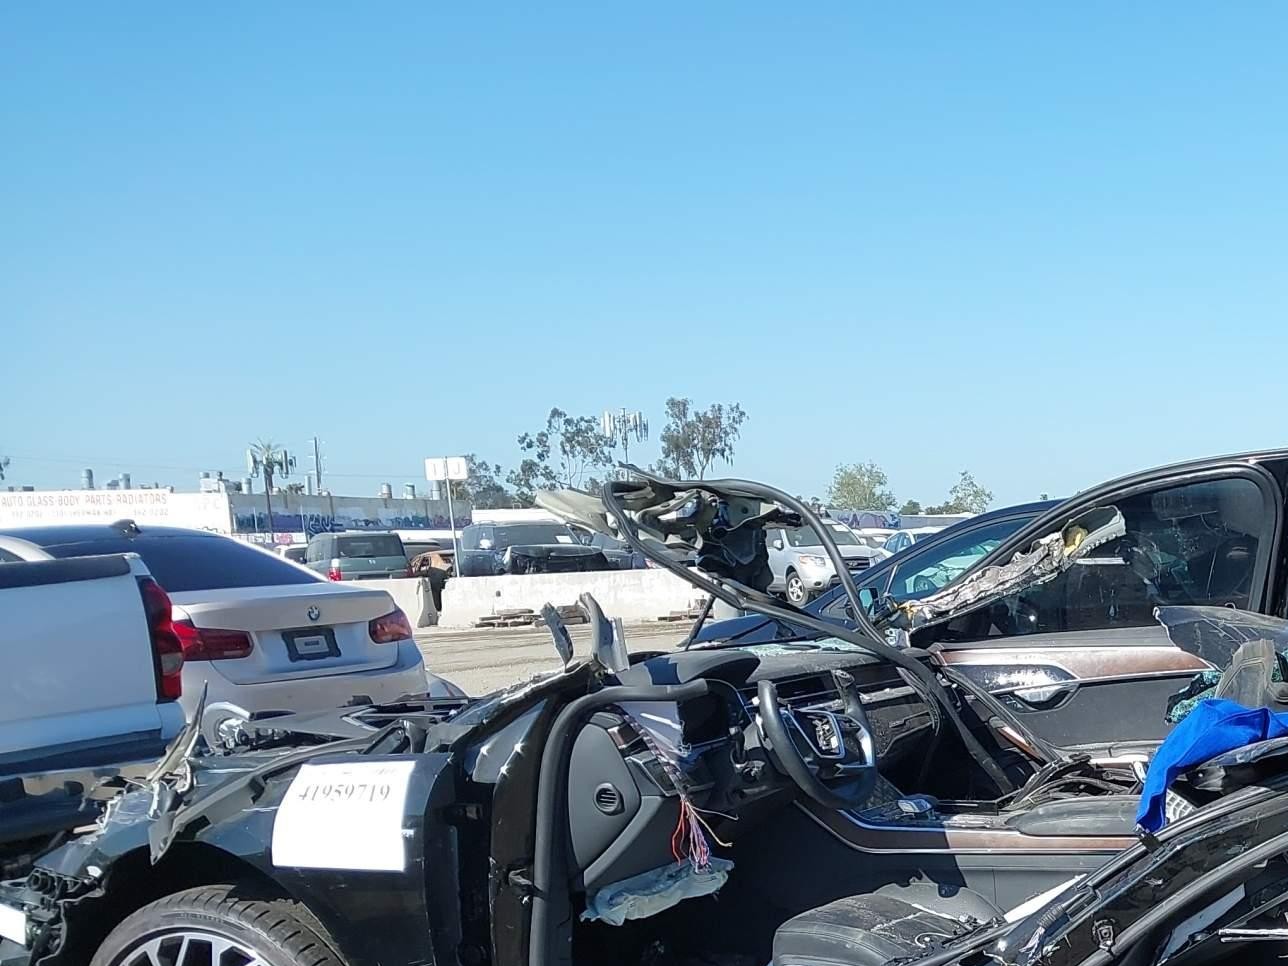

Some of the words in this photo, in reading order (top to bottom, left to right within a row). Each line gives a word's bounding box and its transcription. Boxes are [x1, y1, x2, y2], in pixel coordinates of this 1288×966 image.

[1, 495, 24, 507] AUTO
[27, 495, 55, 507] GLASS
[58, 495, 80, 506] BODY
[85, 494, 112, 506] PARTS
[116, 493, 167, 505] RADIATORS
